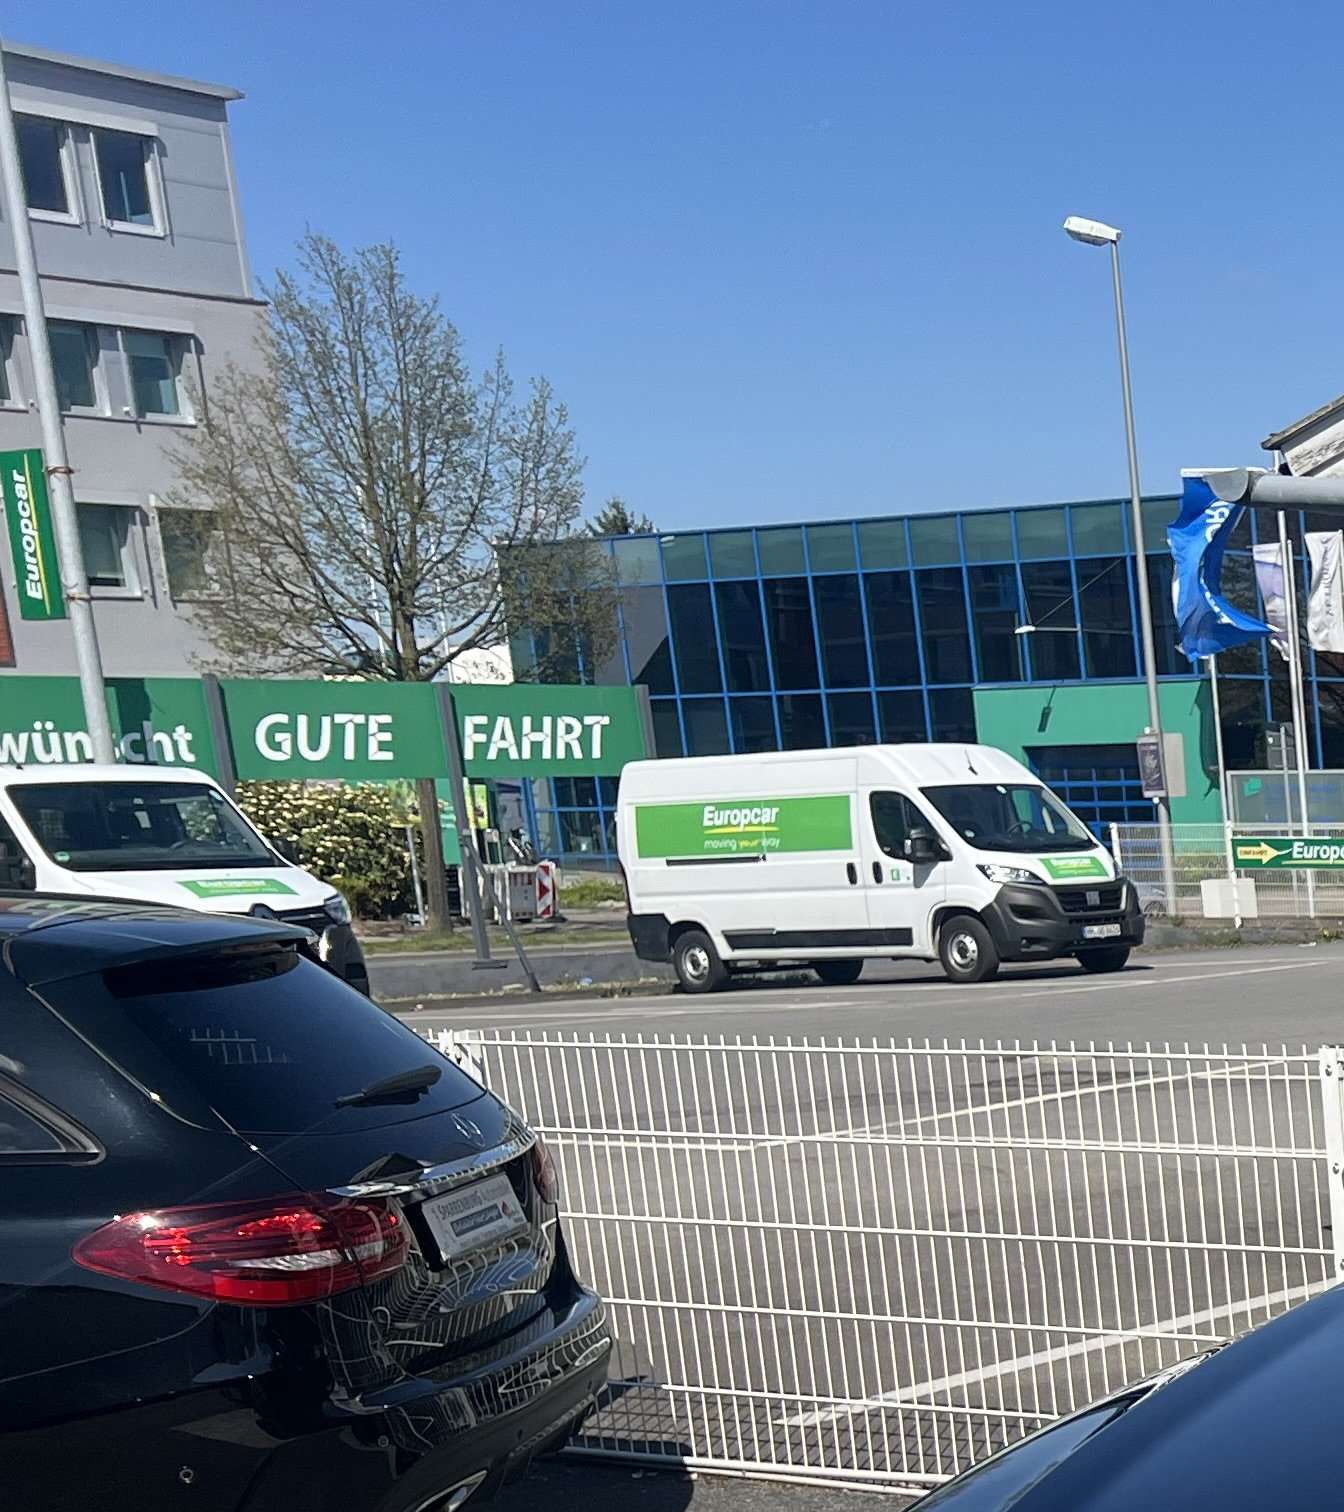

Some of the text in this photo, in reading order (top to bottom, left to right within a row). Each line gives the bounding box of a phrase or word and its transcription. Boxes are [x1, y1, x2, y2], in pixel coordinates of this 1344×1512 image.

[13, 469, 43, 600] Europcar
[0, 713, 610, 764] wüncht GUTE FAHRT
[703, 806, 779, 832] Europcar
